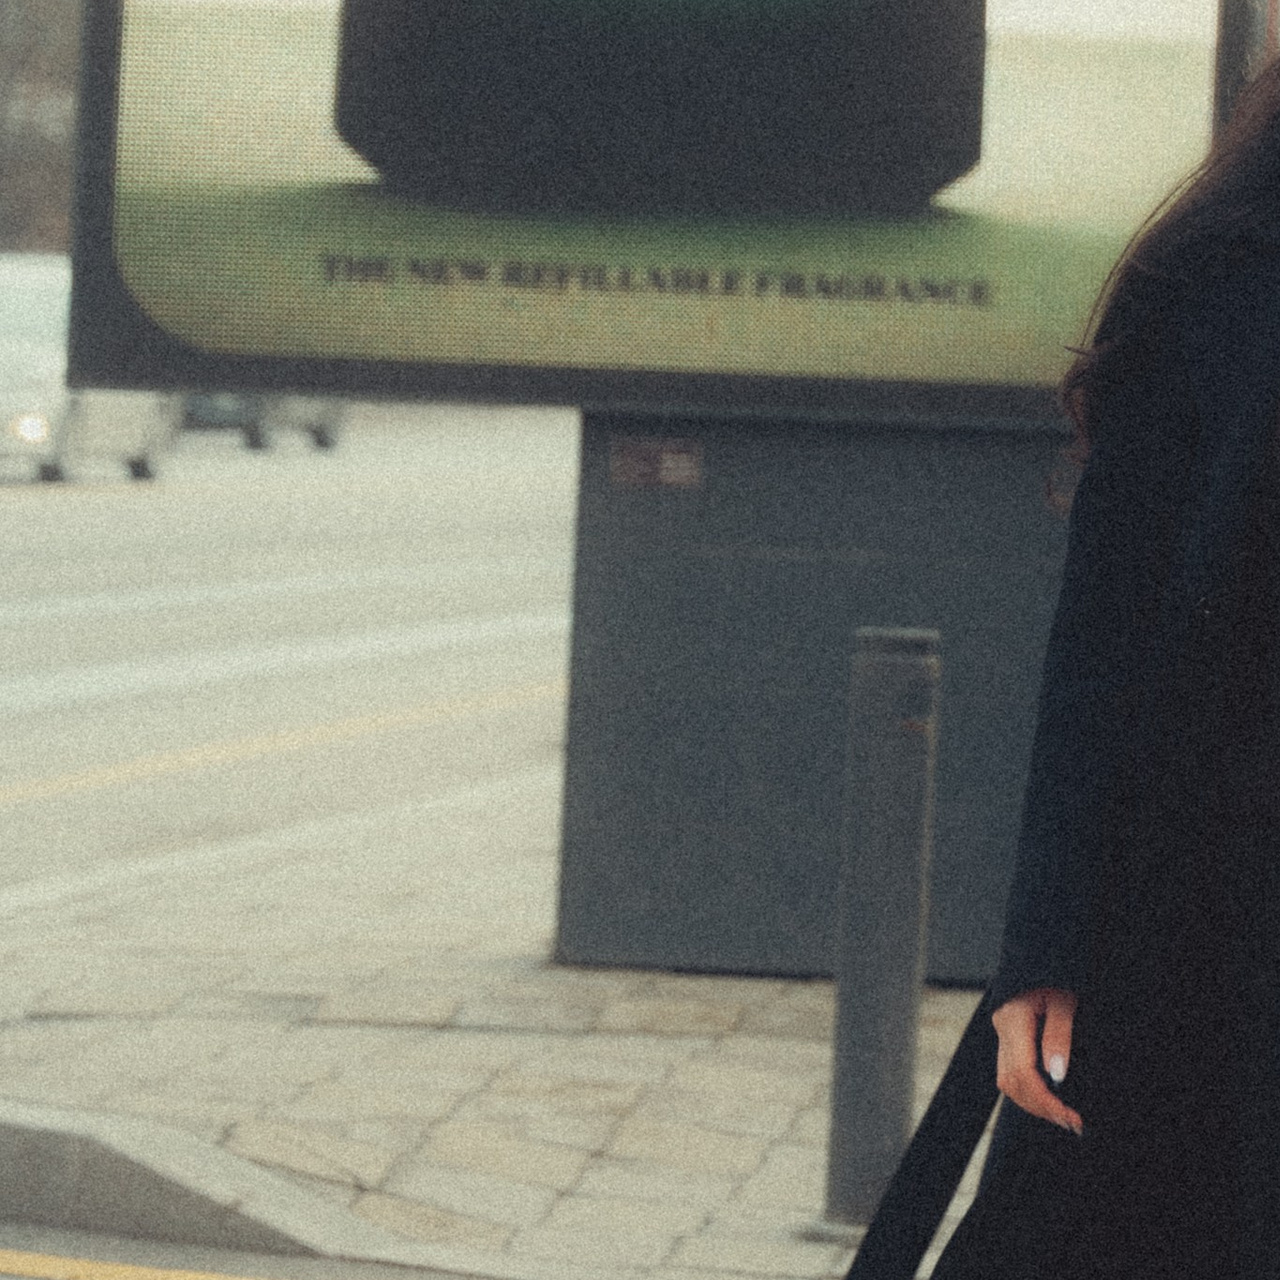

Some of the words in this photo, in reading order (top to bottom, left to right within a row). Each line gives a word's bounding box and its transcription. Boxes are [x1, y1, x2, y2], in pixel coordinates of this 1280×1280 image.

[323, 252, 390, 283] THE
[406, 254, 489, 287] NEW
[502, 258, 740, 296] REFILLABLE
[753, 267, 992, 302] FRAGRANCE
